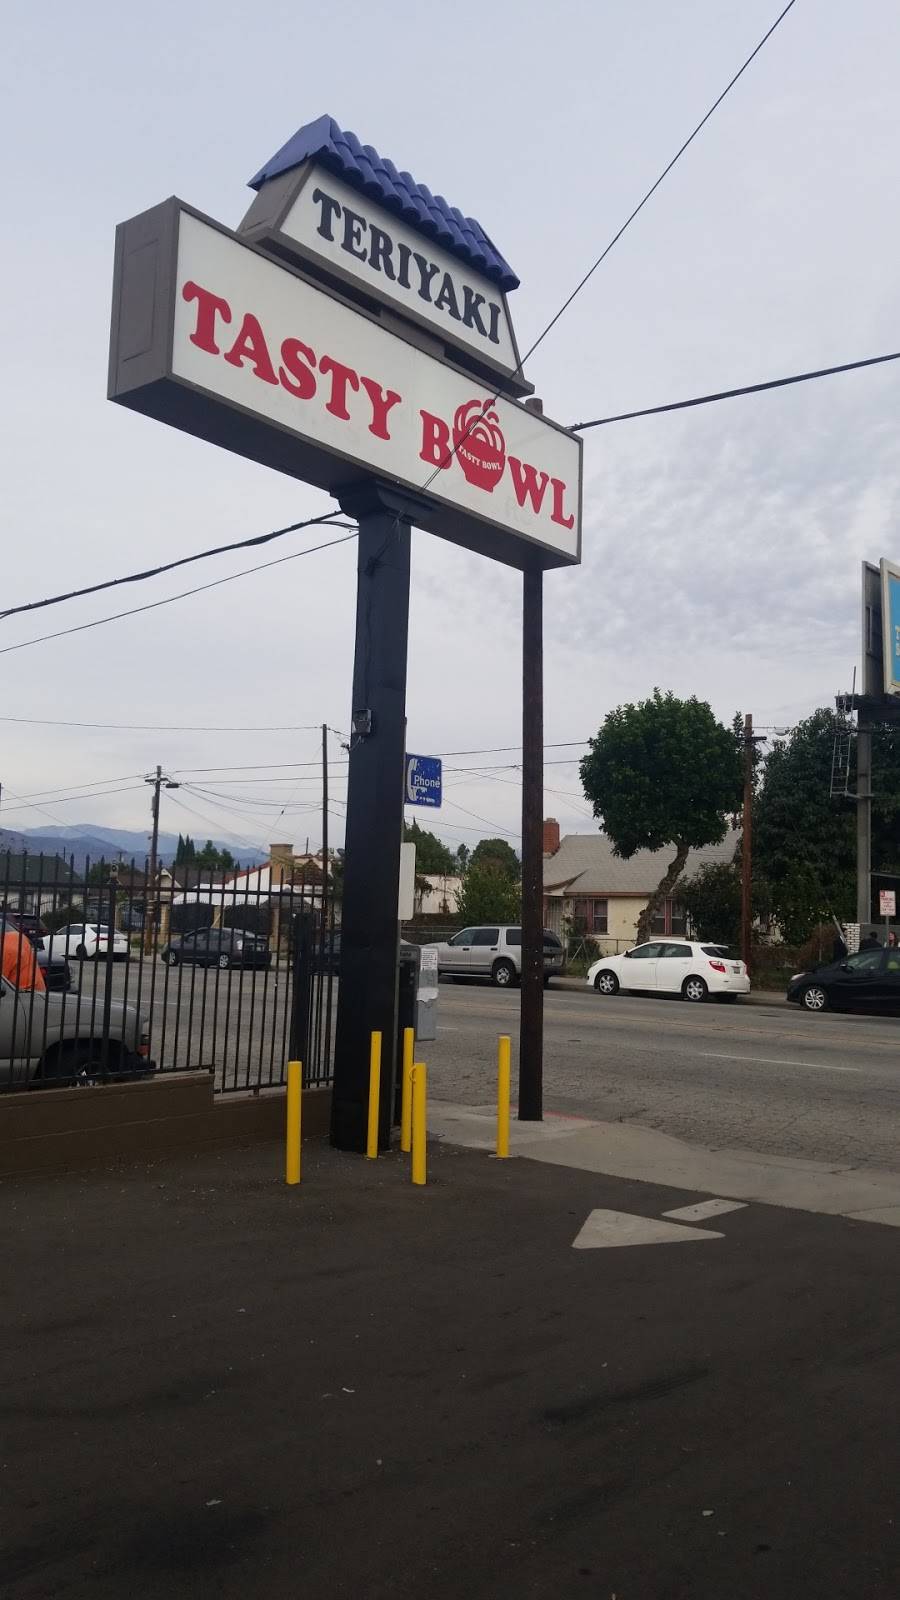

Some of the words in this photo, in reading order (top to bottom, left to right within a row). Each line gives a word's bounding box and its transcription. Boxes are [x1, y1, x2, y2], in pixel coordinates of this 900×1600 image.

[312, 188, 502, 345] TERIYAKI
[182, 281, 402, 441] TASTY
[459, 444, 481, 466] TASTY
[482, 461, 503, 471] BOWL
[413, 774, 441, 788] Phone
